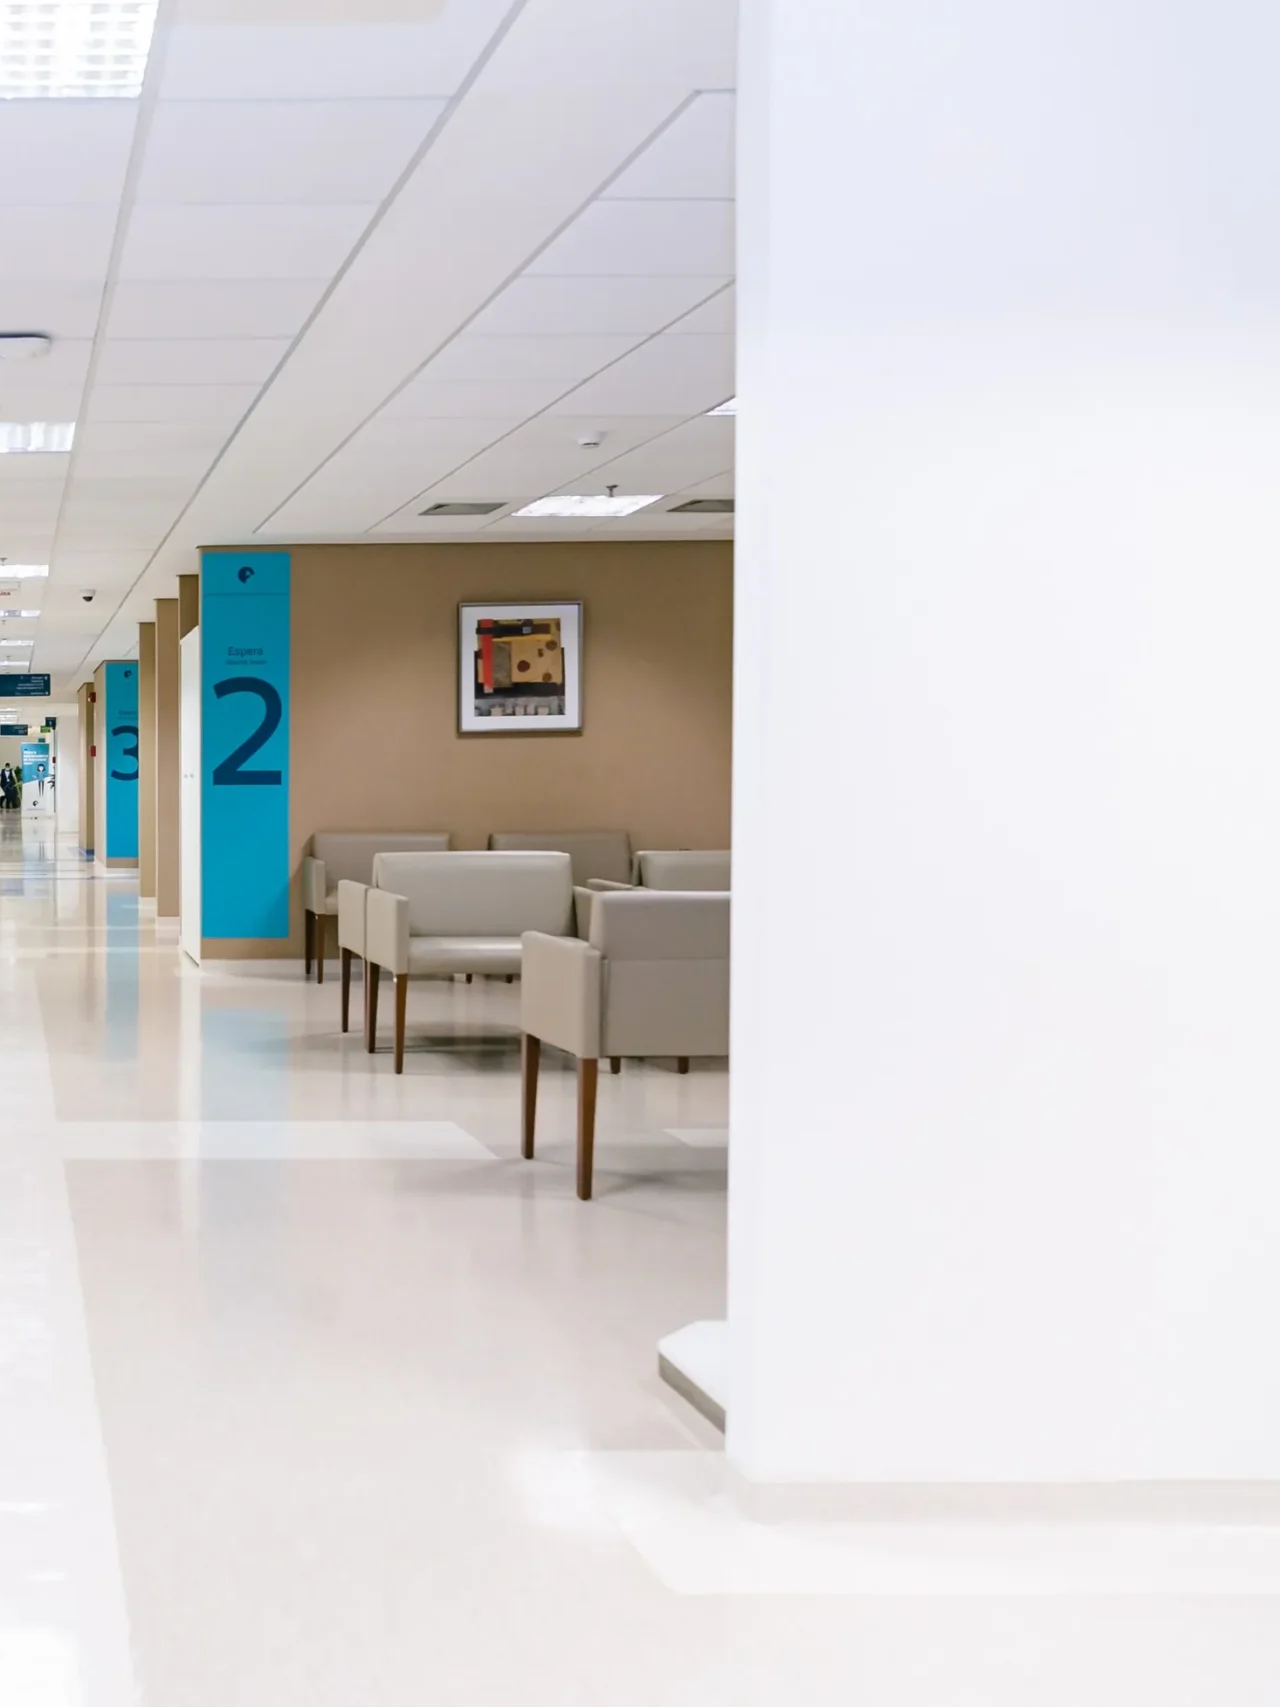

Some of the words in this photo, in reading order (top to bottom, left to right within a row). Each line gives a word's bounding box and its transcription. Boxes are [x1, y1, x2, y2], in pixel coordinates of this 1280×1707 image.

[228, 646, 264, 658] Espera
[111, 725, 139, 781] 3
[213, 676, 282, 785] 2
